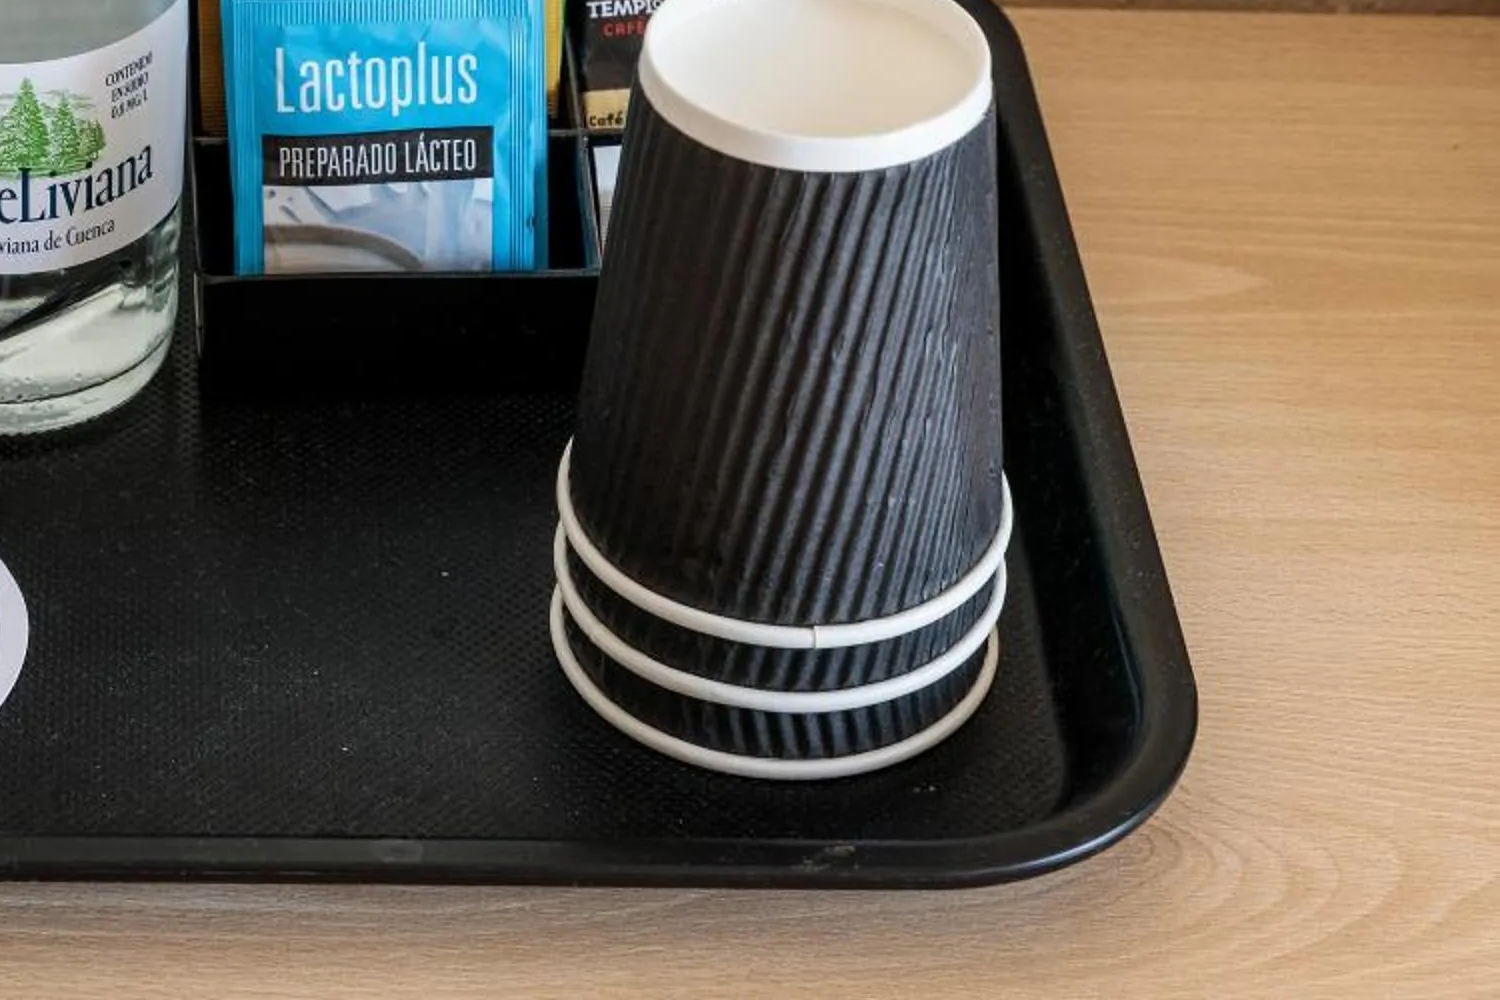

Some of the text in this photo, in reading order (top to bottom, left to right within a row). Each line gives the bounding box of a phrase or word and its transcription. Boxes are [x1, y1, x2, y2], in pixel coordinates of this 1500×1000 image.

[275, 41, 478, 117] Lactoplus
[589, 110, 625, 127] Café
[279, 132, 477, 178] PREPARADO LÁCTEO
[43, 229, 62, 251] de
[65, 219, 115, 247] Cuenca
